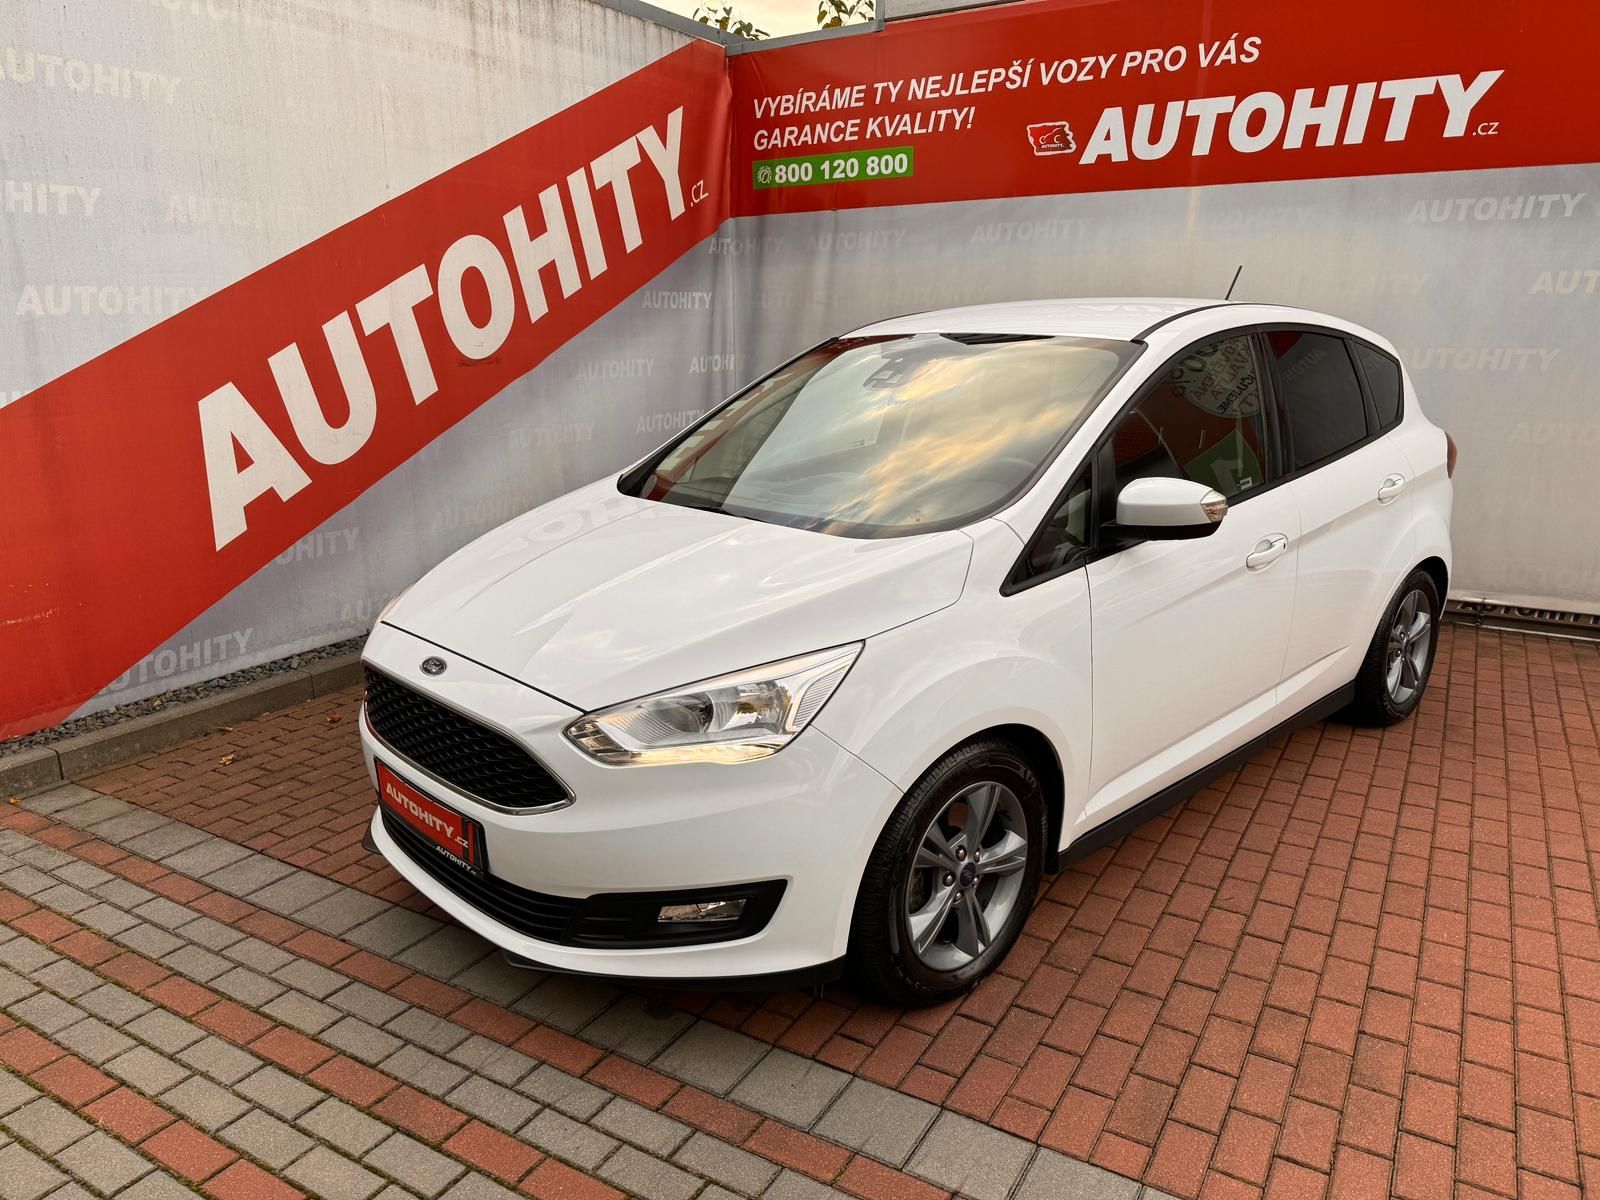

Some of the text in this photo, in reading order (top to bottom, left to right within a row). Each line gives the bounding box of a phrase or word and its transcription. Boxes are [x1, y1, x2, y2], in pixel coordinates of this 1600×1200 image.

[753, 33, 1262, 119] VYBÍRÁME TY NEJLEPŠÍ VOZY PRO VÁS
[753, 107, 976, 151] GARANCE KVALITY!
[775, 162, 813, 184] 800
[820, 157, 859, 180] 120
[866, 153, 908, 176] 800
[1408, 192, 1586, 223] AUTOHITY
[642, 291, 713, 311] AUTOHITY
[576, 358, 655, 381] AUTOHITY
